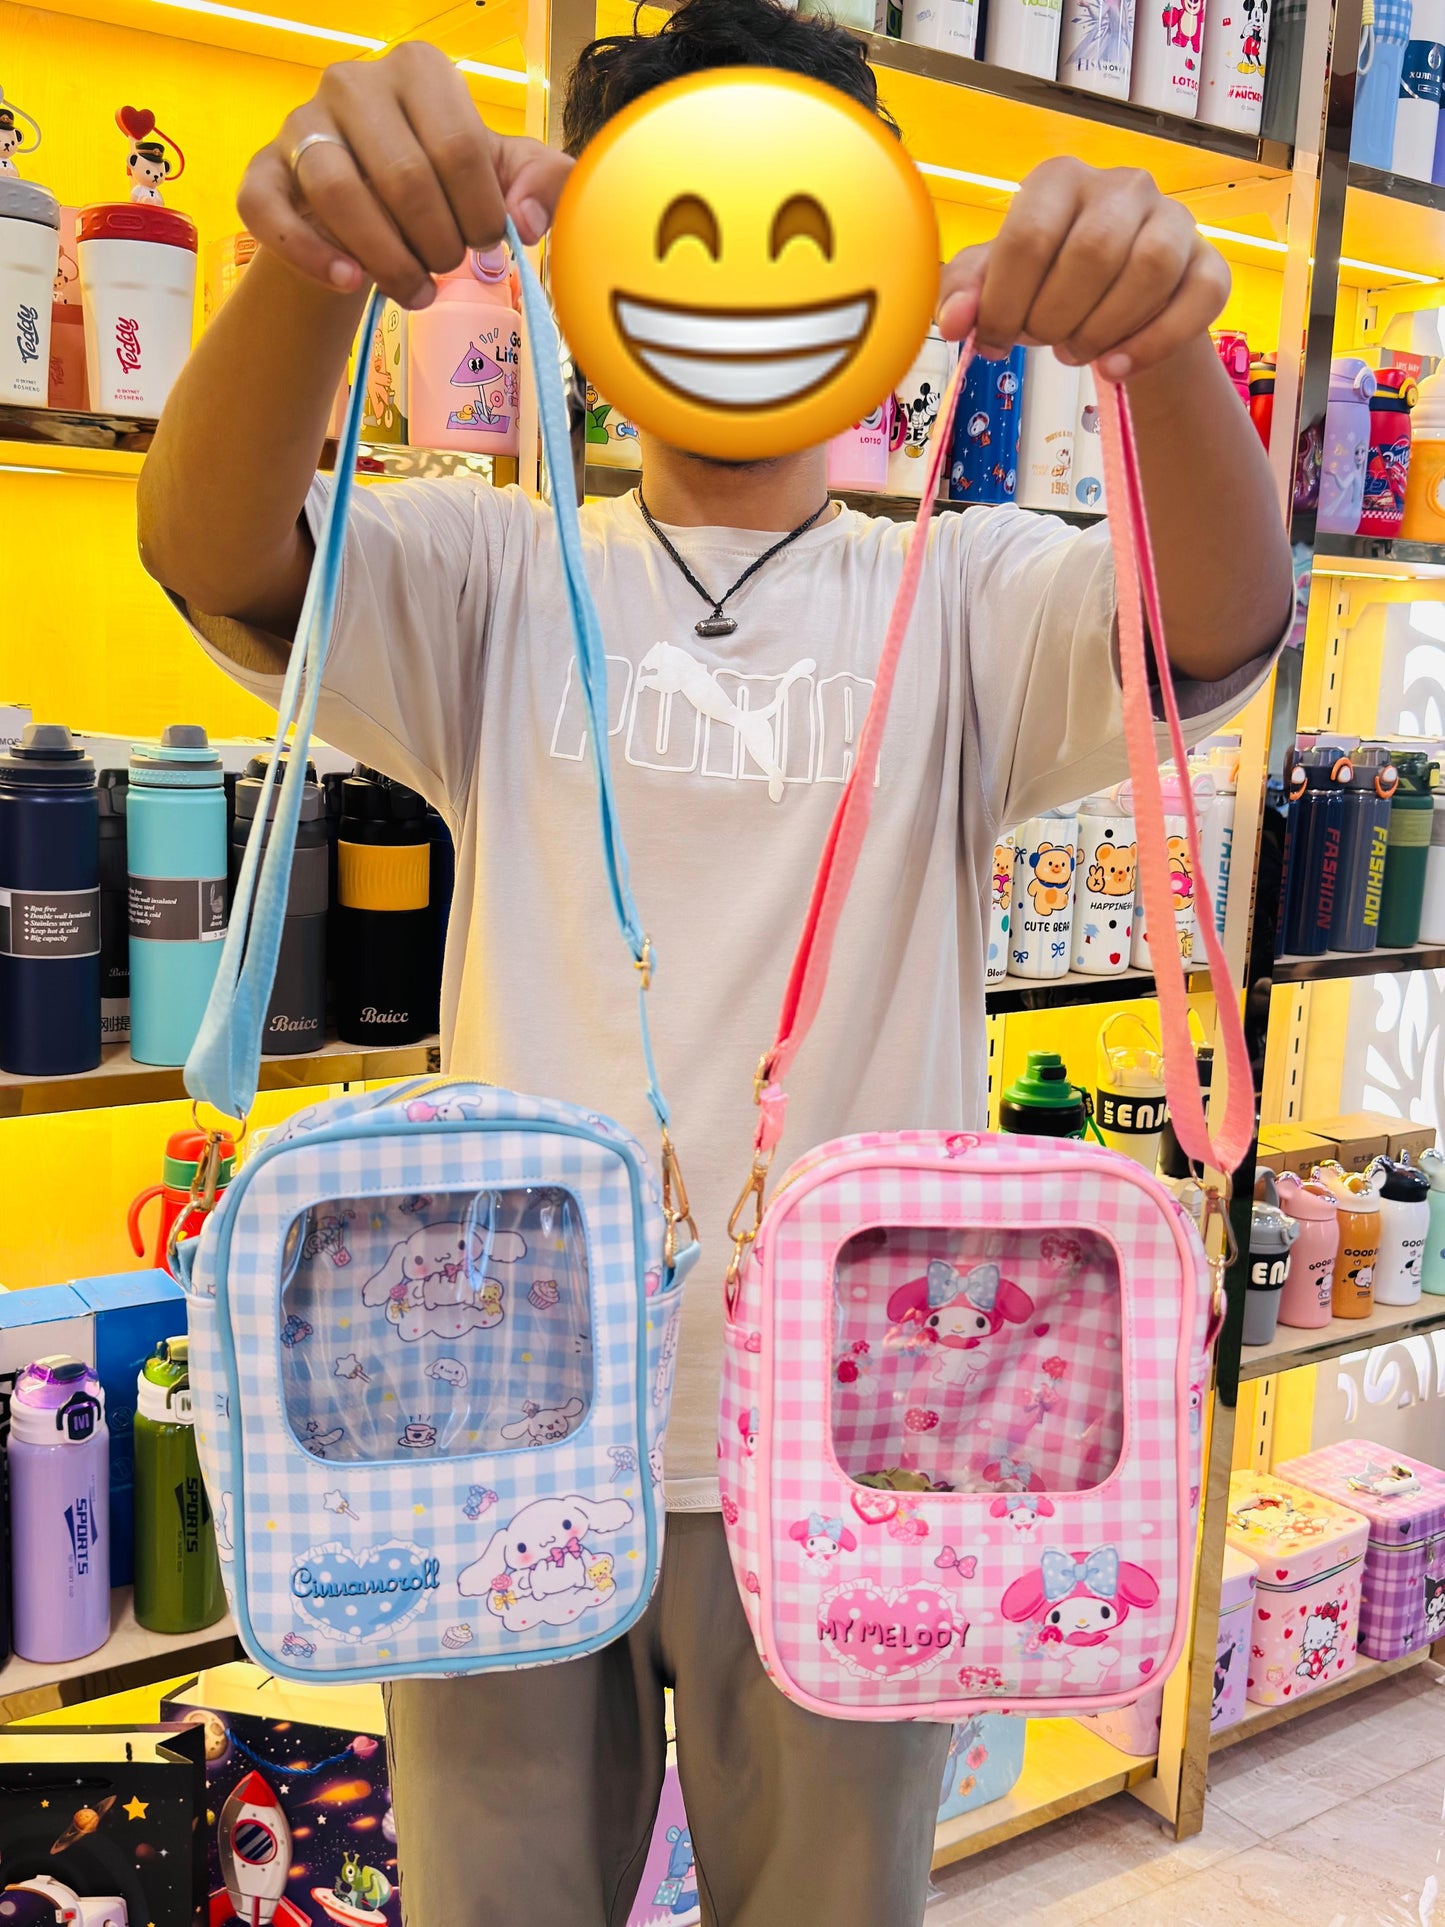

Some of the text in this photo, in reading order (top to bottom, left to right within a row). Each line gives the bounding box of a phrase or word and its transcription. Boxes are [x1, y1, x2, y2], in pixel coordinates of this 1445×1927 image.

[17, 304, 39, 363] Teddy
[115, 317, 141, 374] Teddy
[496, 346, 518, 364] Life
[860, 437, 881, 445] LOTSO
[549, 655, 880, 787] PUMA
[1316, 827, 1341, 929] FASHION
[1363, 826, 1388, 927] FASHION
[42, 935, 68, 943] capacity
[1024, 921, 1070, 932] CUTE BEAR
[75, 1498, 88, 1575] SPORTS
[186, 1478, 199, 1552] SPORTS
[291, 1557, 440, 1598] Cinnamoroll
[817, 1619, 970, 1648] MY MELODY
